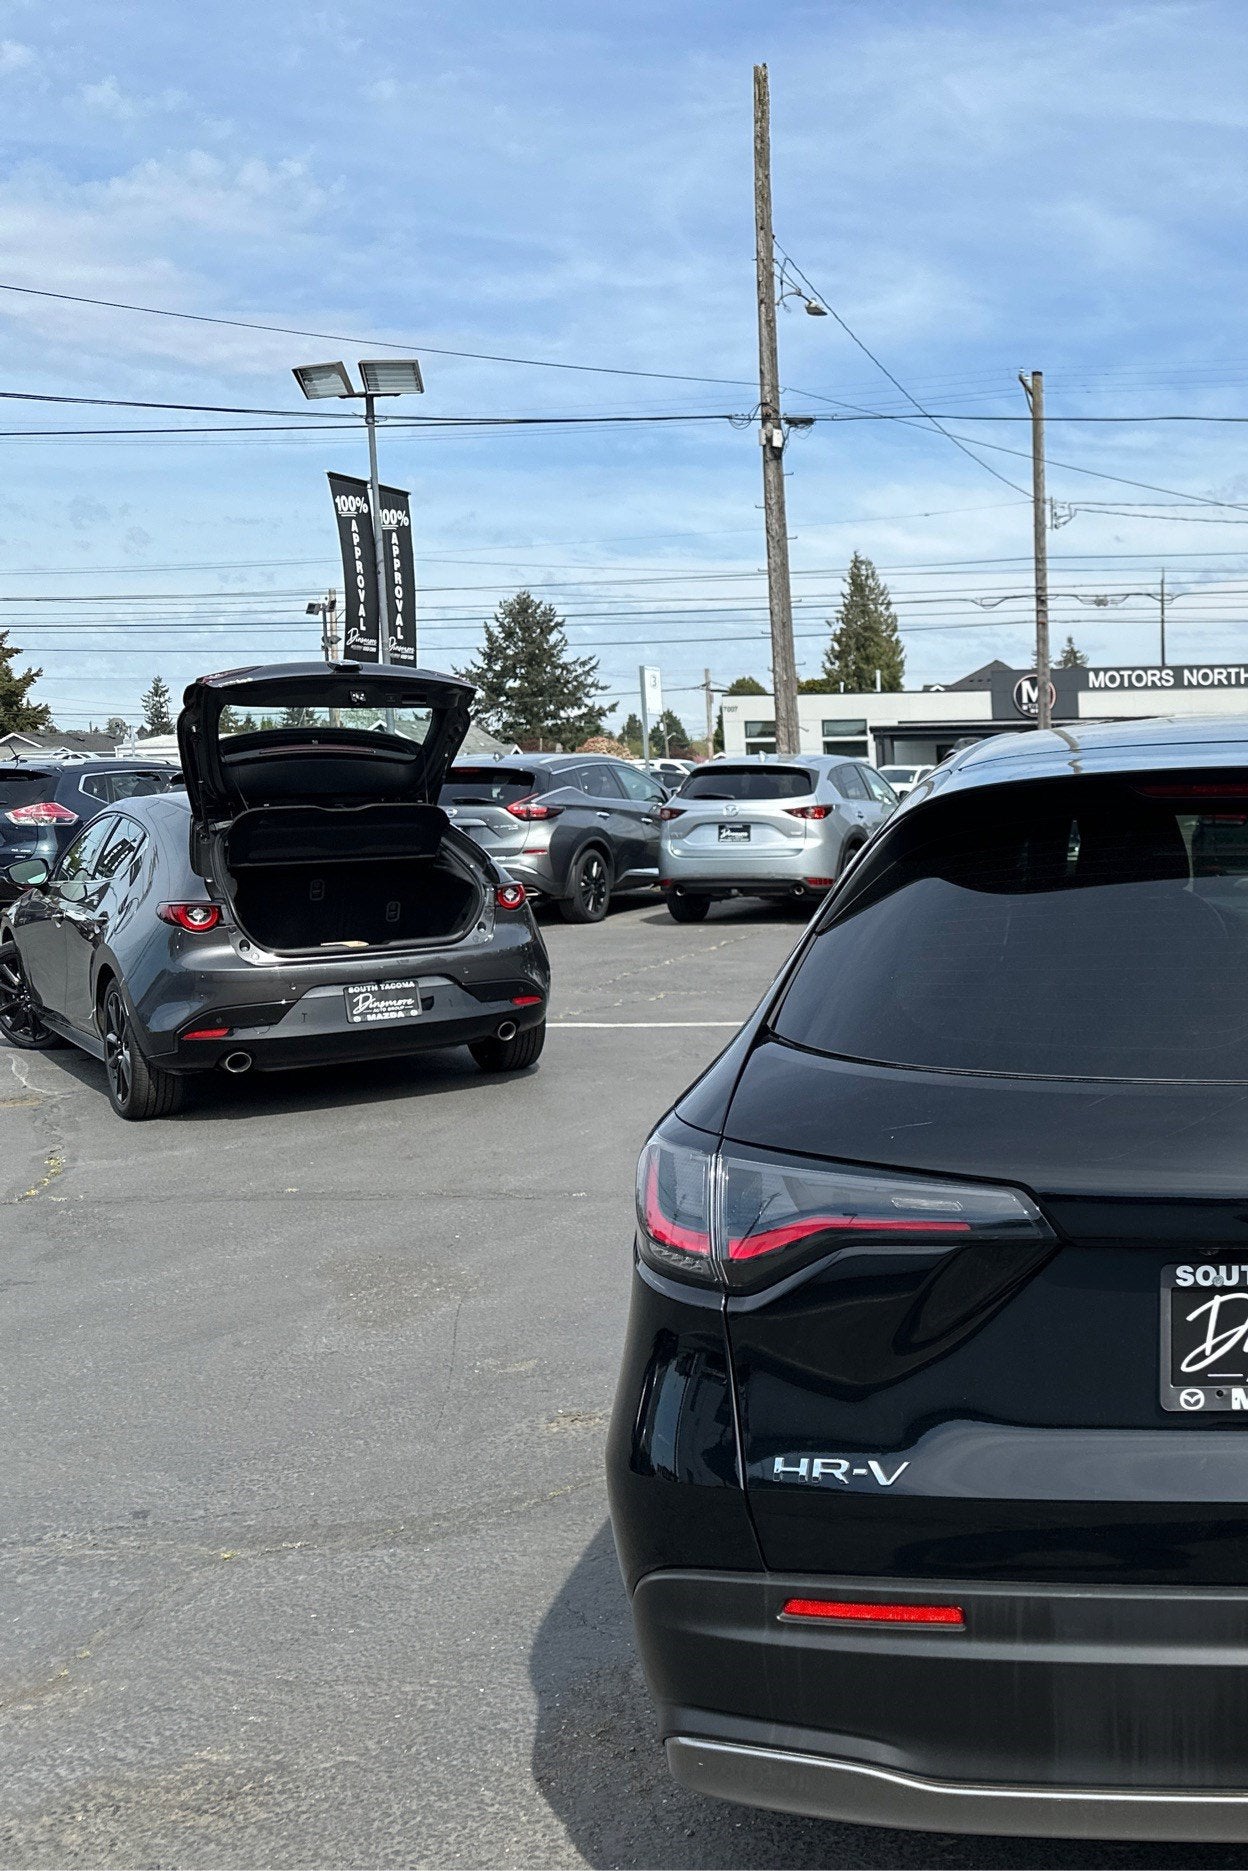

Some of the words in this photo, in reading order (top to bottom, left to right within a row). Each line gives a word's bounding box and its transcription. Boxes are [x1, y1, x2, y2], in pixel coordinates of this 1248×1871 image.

[335, 495, 369, 513] 100%
[351, 519, 366, 631] APPROVAL
[391, 532, 404, 640] APPROVAL
[1088, 668, 1175, 689] MOTORS
[348, 984, 378, 994] SOUTH
[379, 981, 416, 991] TACOMA
[352, 992, 415, 1015] Dinsmore
[366, 1011, 405, 1021] MAZDA
[773, 1457, 911, 1486] HR-V
